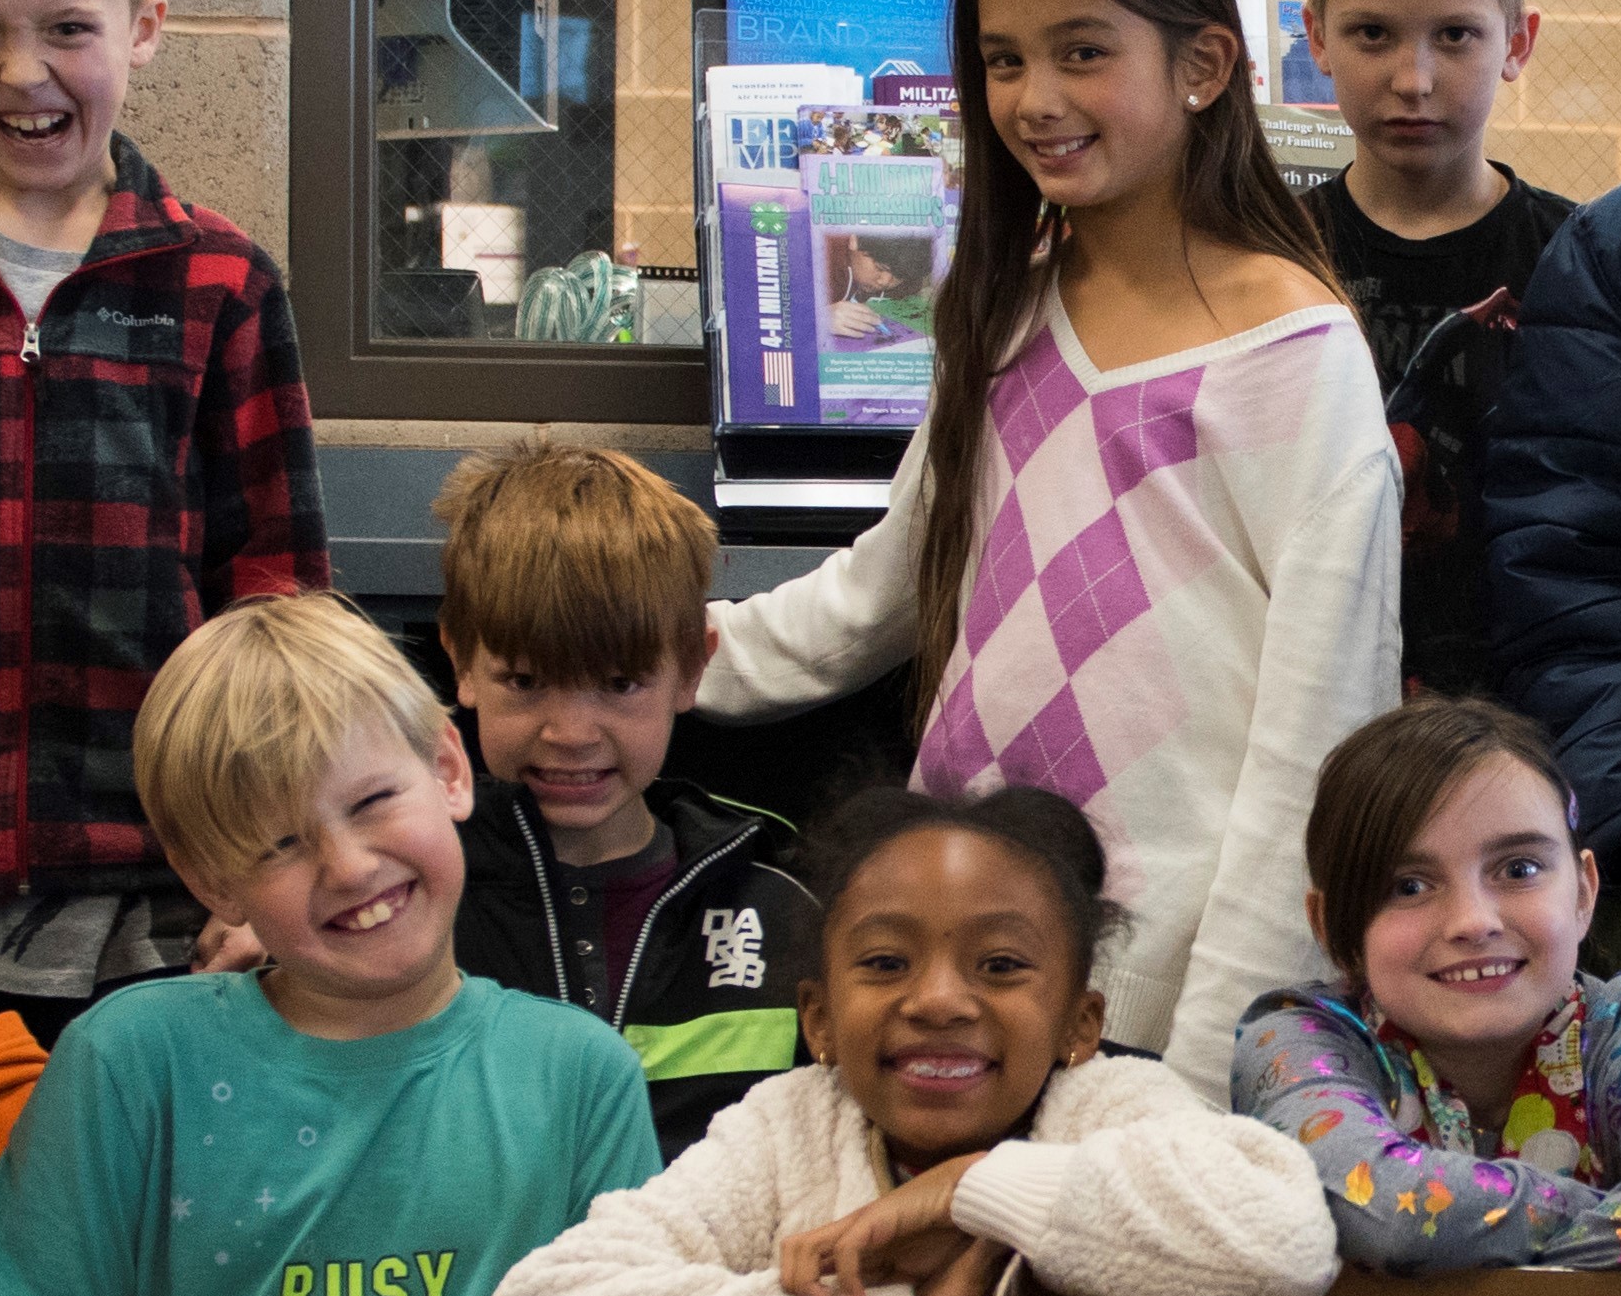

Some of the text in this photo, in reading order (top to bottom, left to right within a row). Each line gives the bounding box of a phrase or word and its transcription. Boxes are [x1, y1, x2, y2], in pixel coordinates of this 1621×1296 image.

[737, 15, 870, 48] BRAND
[1286, 135, 1336, 150] Families
[852, 163, 934, 195] MILITARY
[755, 235, 783, 349] 4-H MILITARY
[779, 237, 793, 349] PARTNERSHIPS
[112, 310, 176, 328] Columbia
